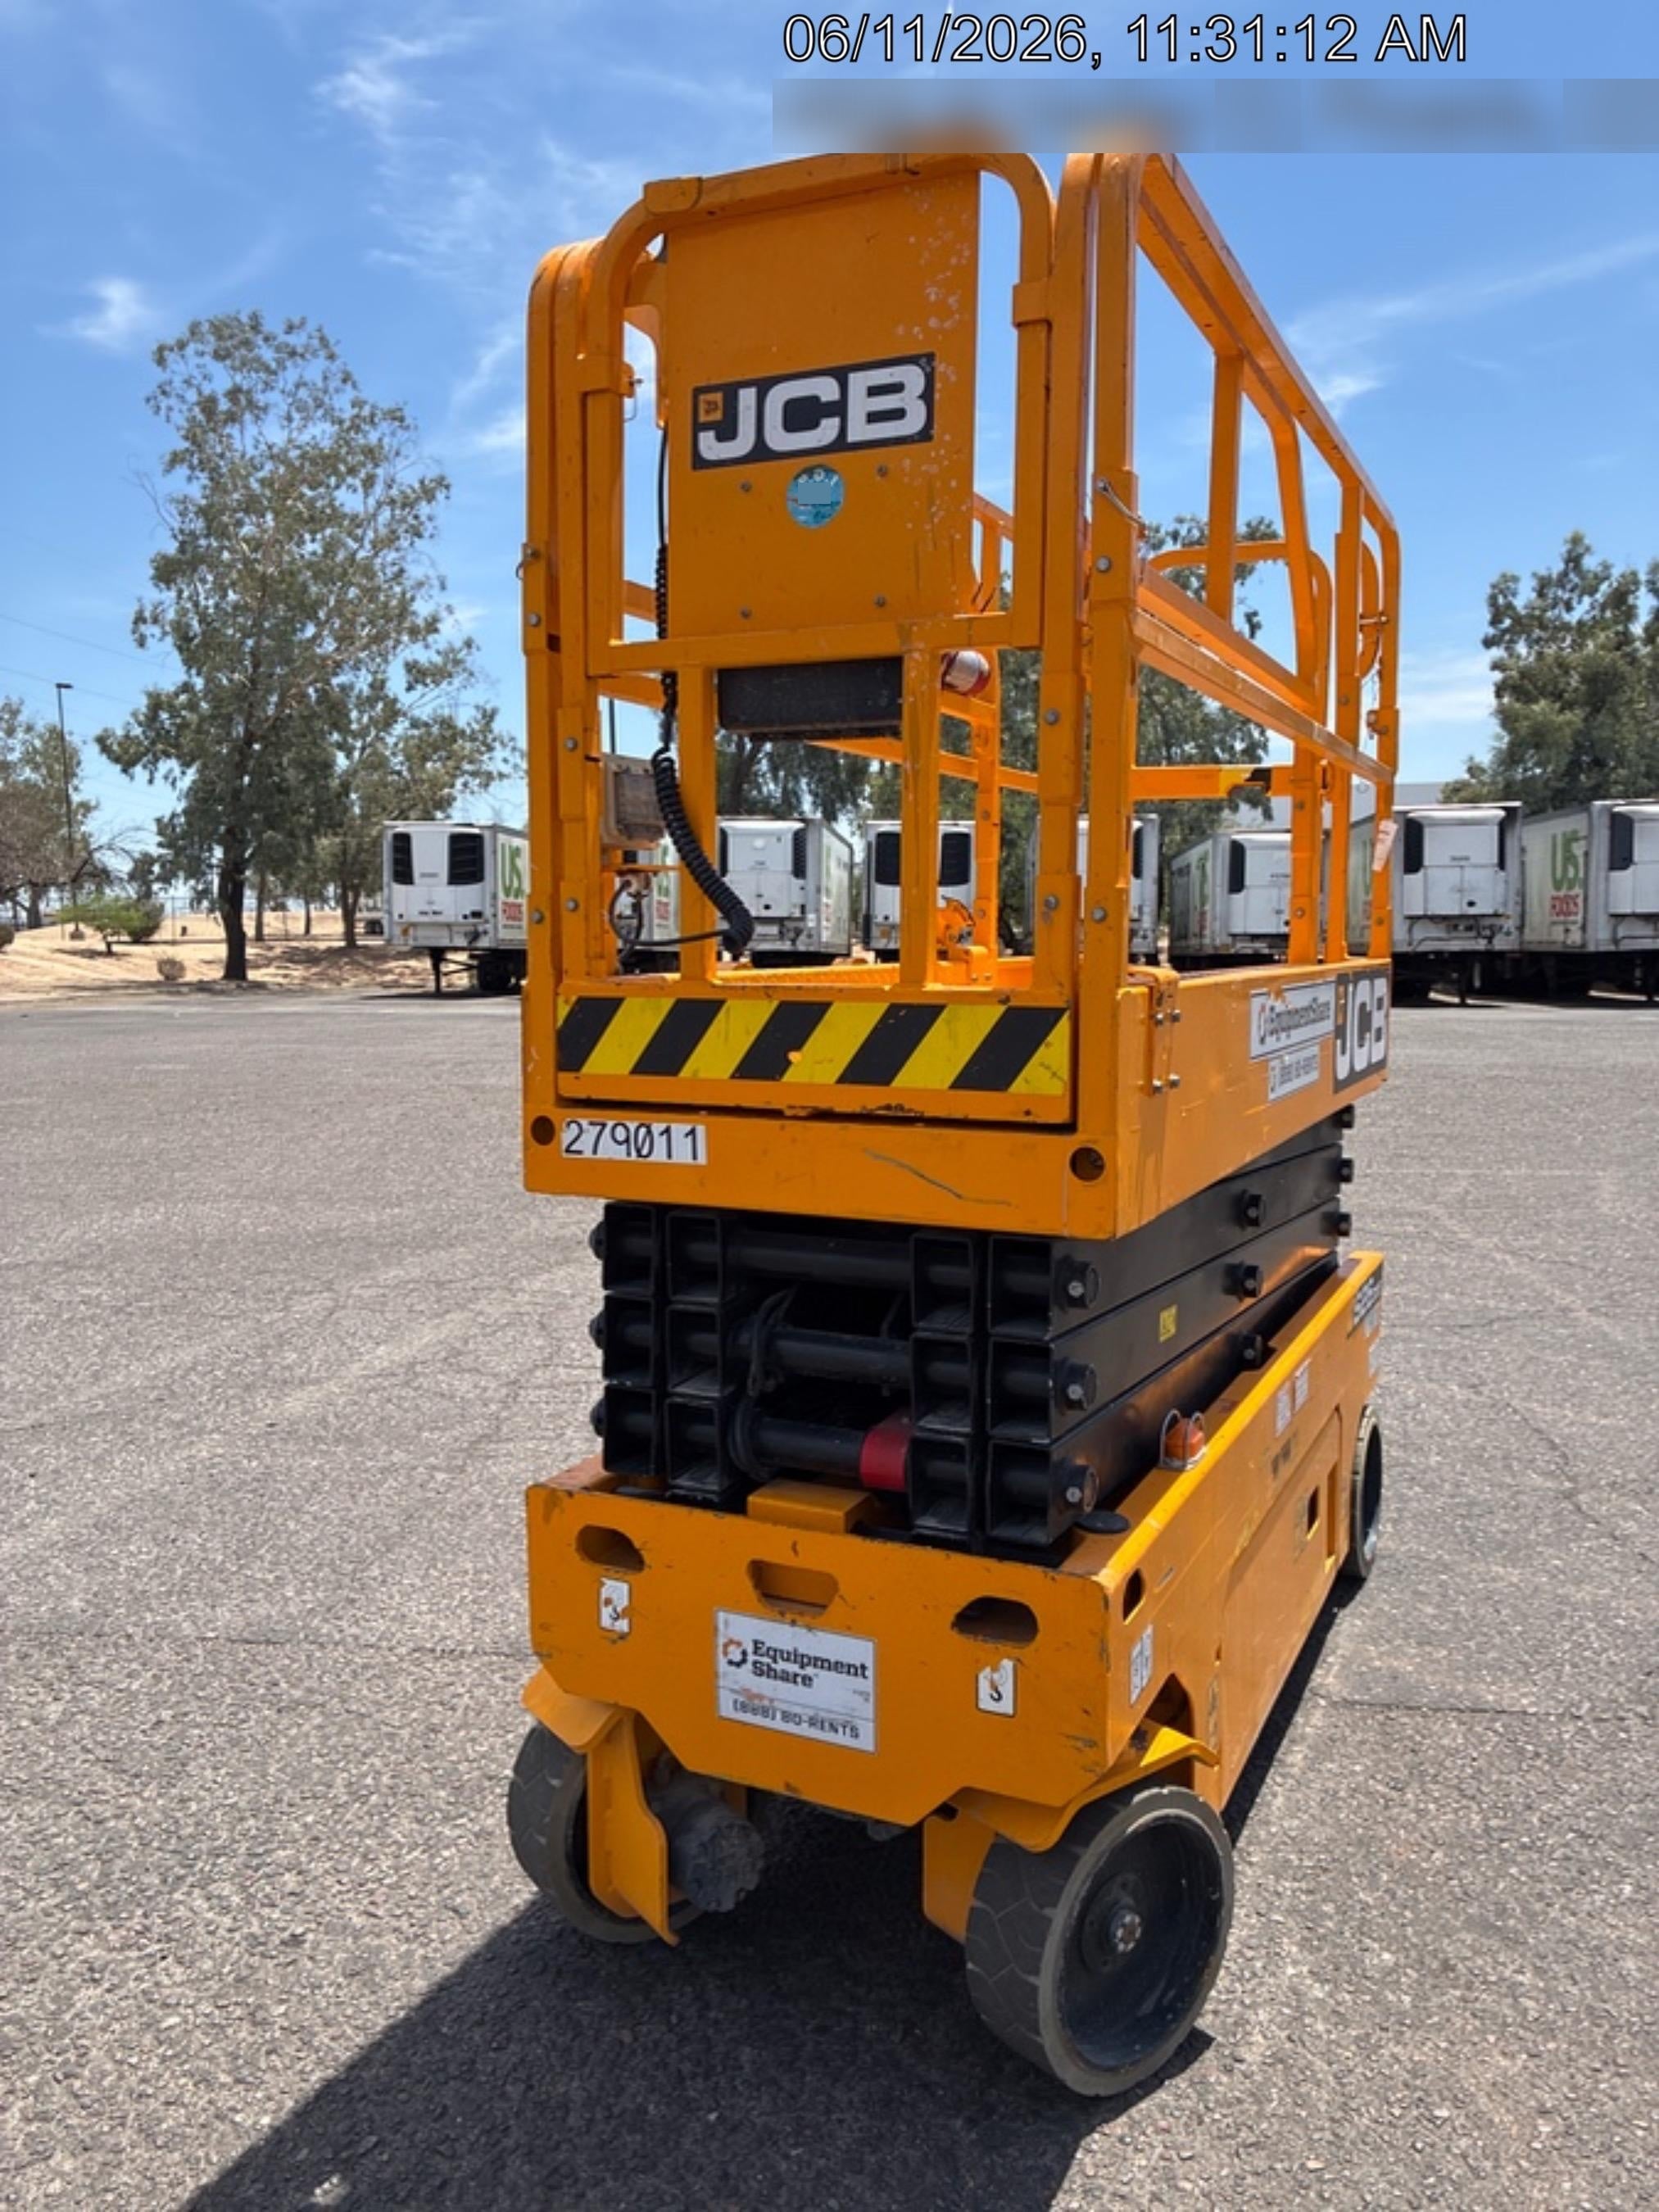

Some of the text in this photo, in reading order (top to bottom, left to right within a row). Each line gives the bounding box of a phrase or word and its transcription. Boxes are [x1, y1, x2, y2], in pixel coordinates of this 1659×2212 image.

[698, 364, 927, 460] JCB
[1336, 977, 1387, 1080] JCB
[564, 1120, 698, 1161] 279011
[751, 1639, 868, 1679] Equipment
[751, 1660, 814, 1688] Share
